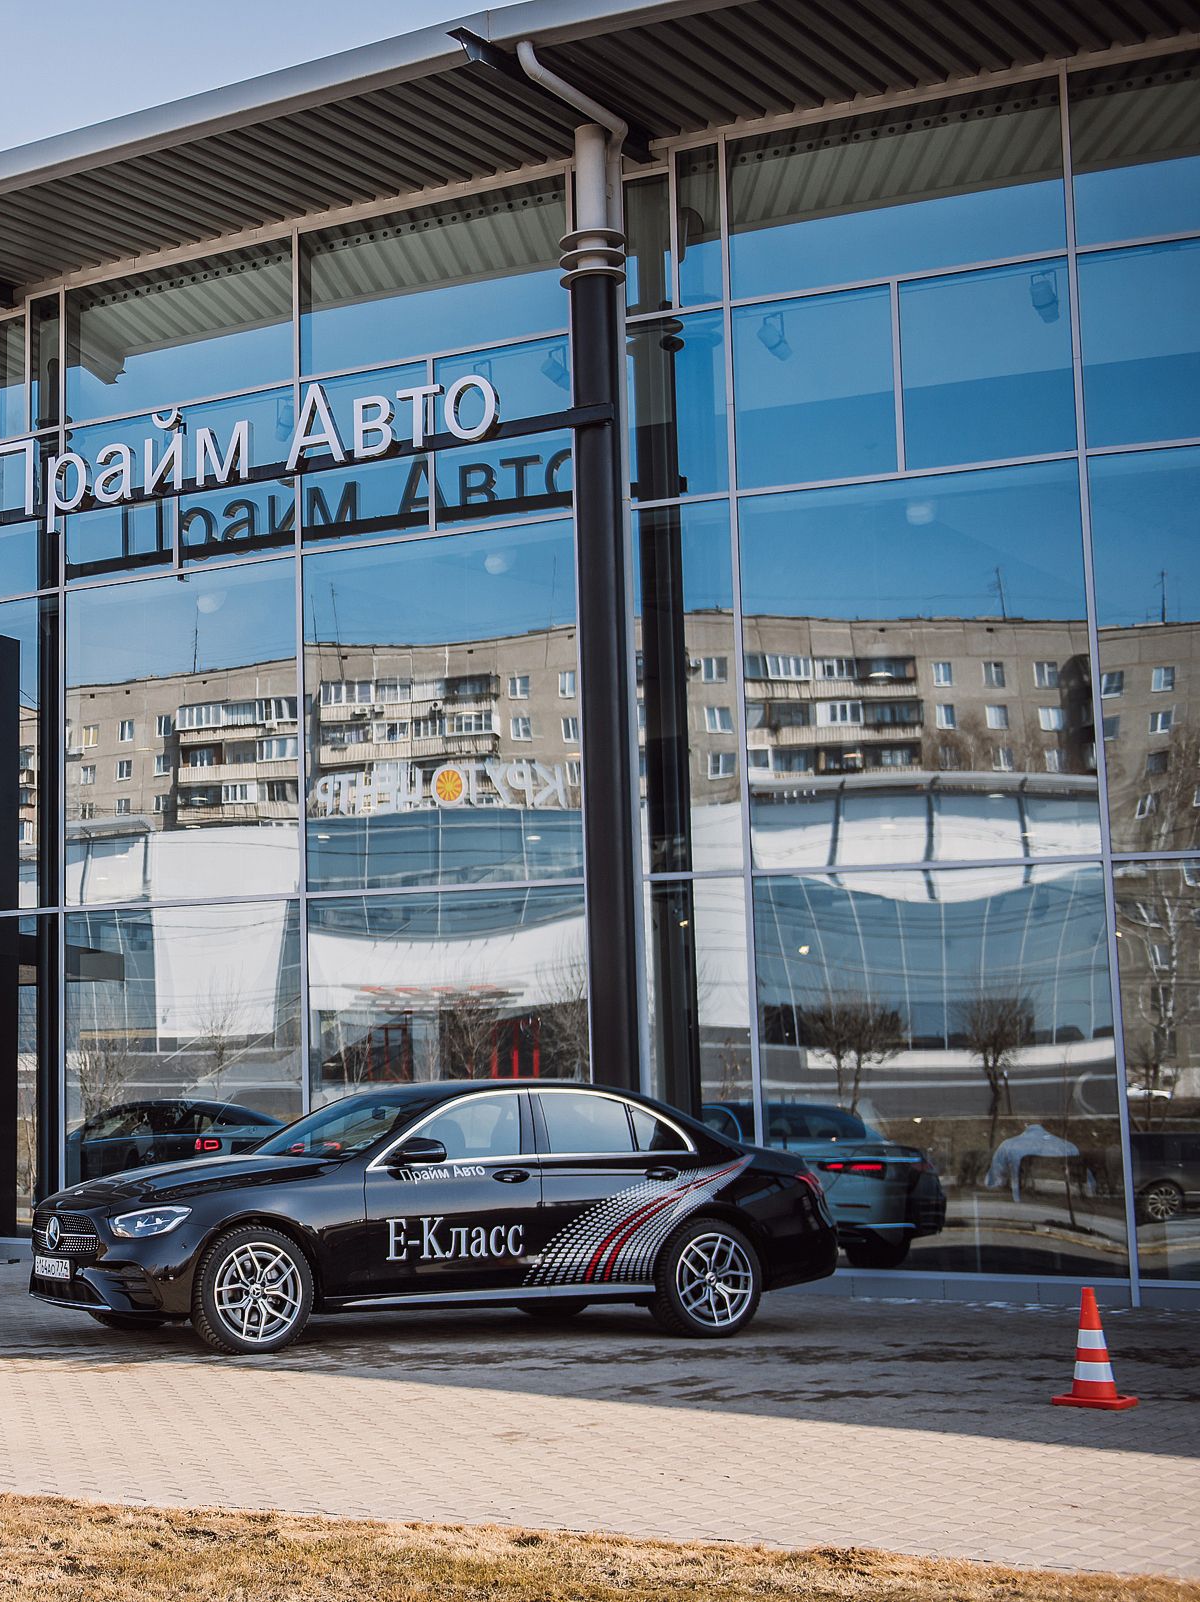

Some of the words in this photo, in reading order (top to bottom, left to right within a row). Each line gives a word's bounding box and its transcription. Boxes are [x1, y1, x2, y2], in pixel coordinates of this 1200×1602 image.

[285, 374, 502, 471] Авто
[400, 1166, 450, 1184] Прайм
[453, 1165, 486, 1178] Авто
[385, 1216, 524, 1261] Е-Класс
